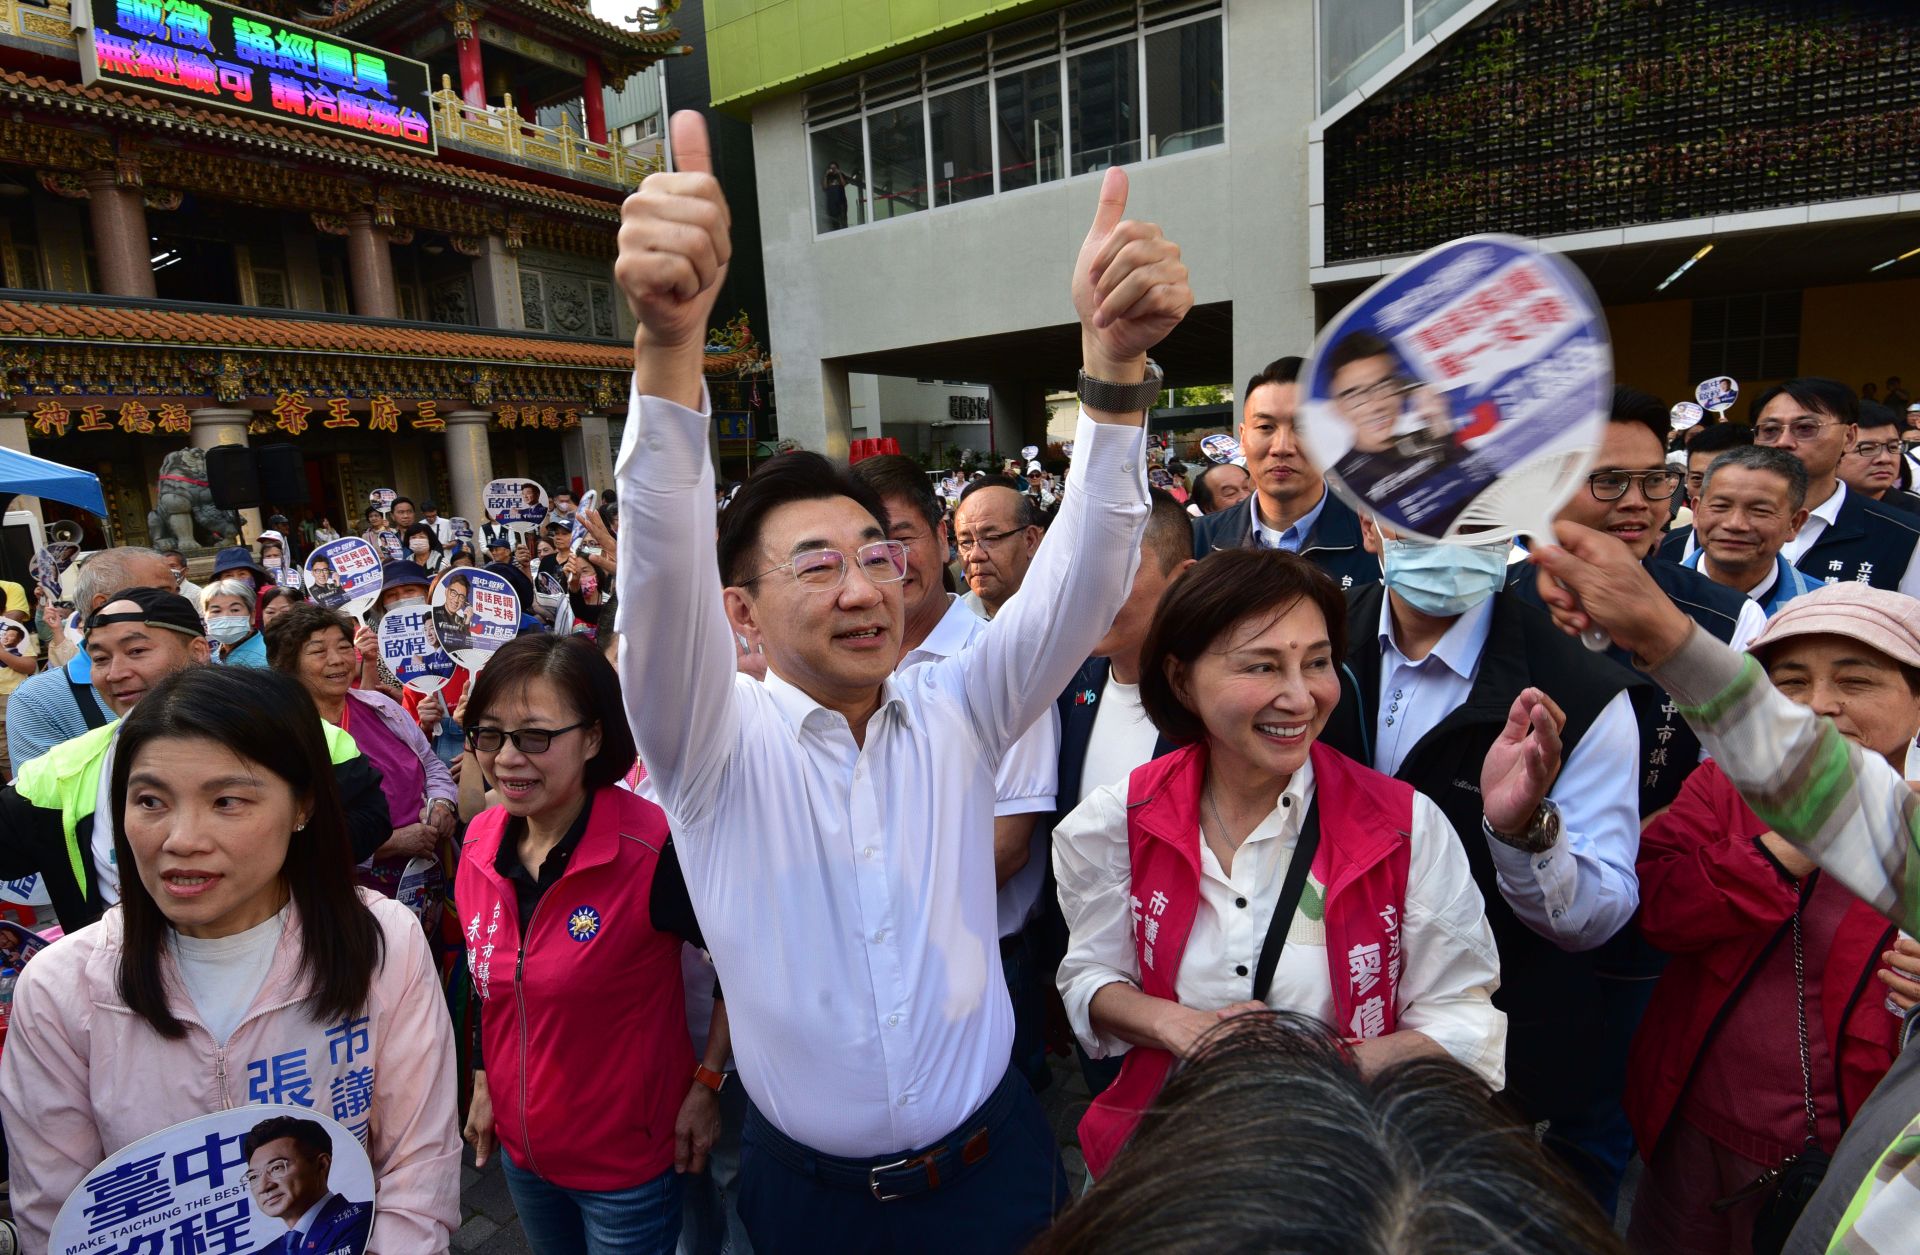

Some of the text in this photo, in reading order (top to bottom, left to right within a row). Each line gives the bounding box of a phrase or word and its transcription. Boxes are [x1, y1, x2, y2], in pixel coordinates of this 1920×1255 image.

[94, 28, 429, 144] 無經驗可 請洽服務台
[232, 16, 393, 99] 誦經團員
[385, 612, 424, 635] 臺中
[475, 590, 513, 609] 電話民調
[475, 601, 514, 621] 唯一支持
[384, 636, 427, 658] 啟程
[1644, 692, 1679, 788] 中市議員
[247, 1048, 315, 1108] 張
[82, 1131, 251, 1235] 臺中
[65, 1183, 250, 1255] MAKE TAICHUNG THE BEST
